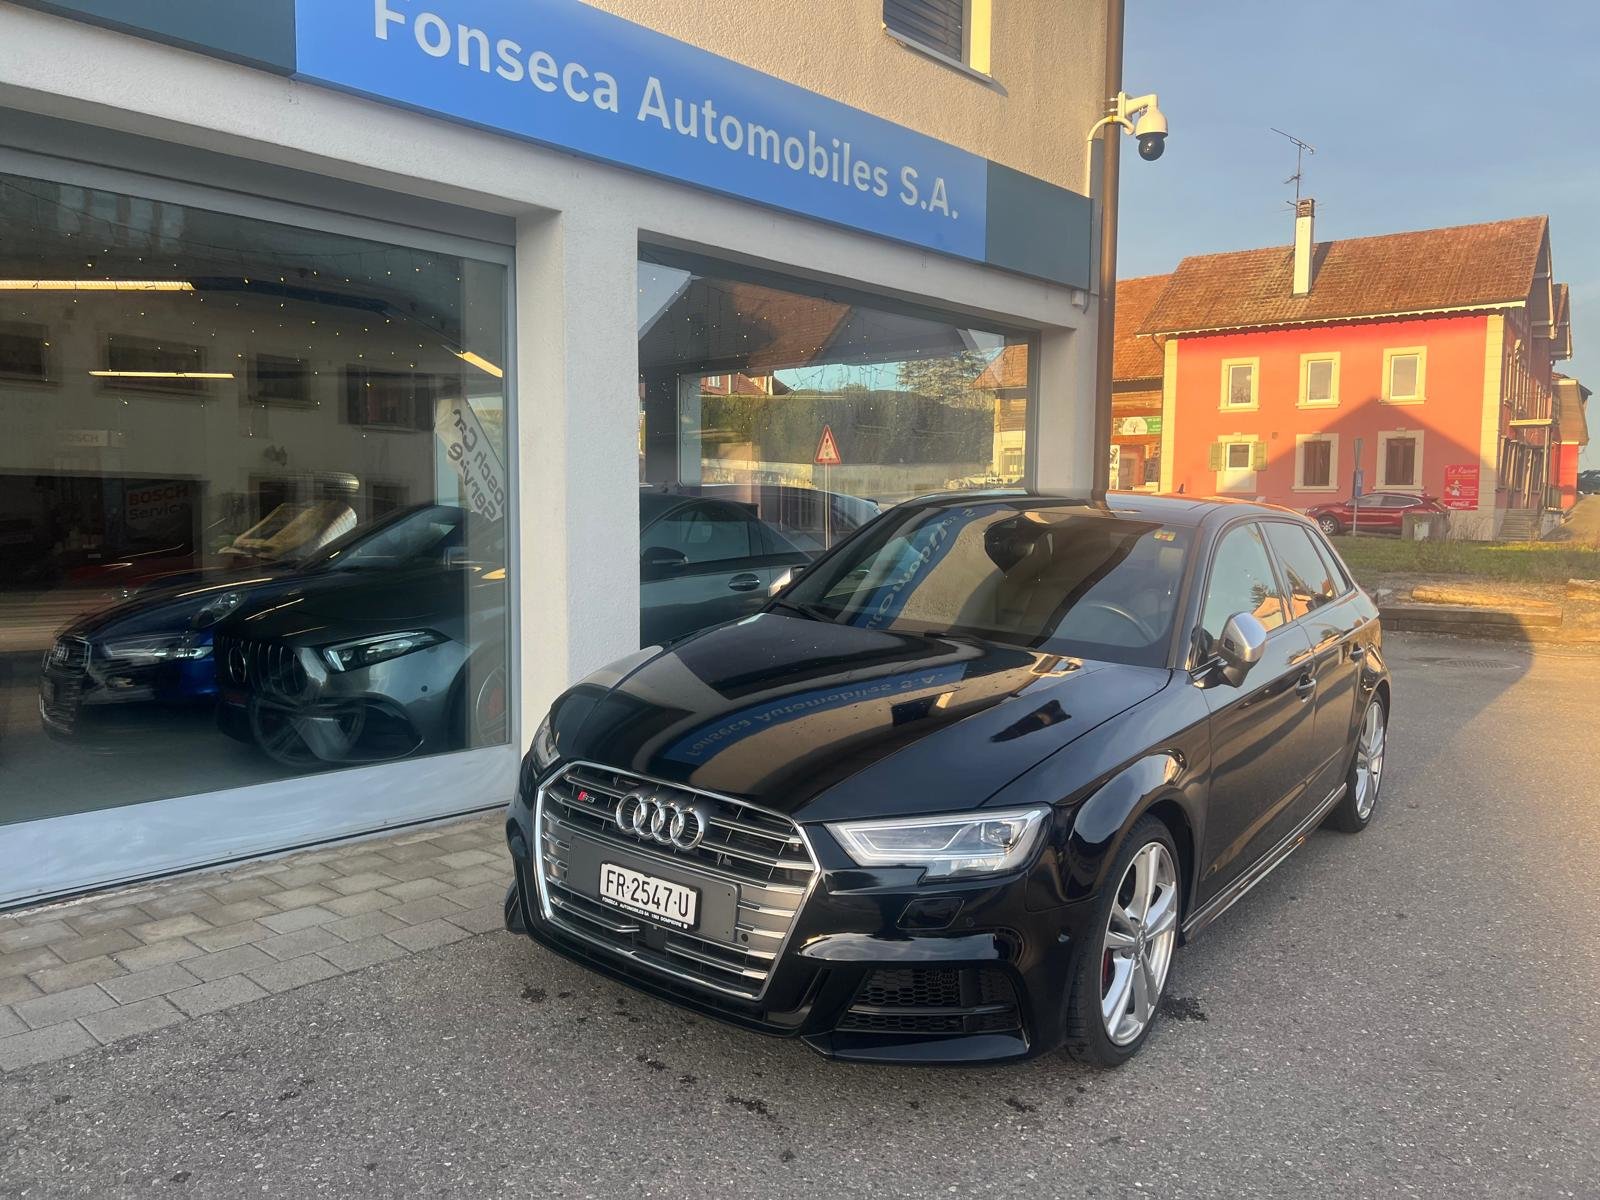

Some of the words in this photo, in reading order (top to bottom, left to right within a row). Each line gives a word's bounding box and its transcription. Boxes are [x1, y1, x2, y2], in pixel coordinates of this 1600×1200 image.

[375, 0, 619, 113] Fonseca
[637, 77, 889, 198] Automobiles
[899, 165, 961, 220] S.A.
[128, 485, 191, 506] BOSCH
